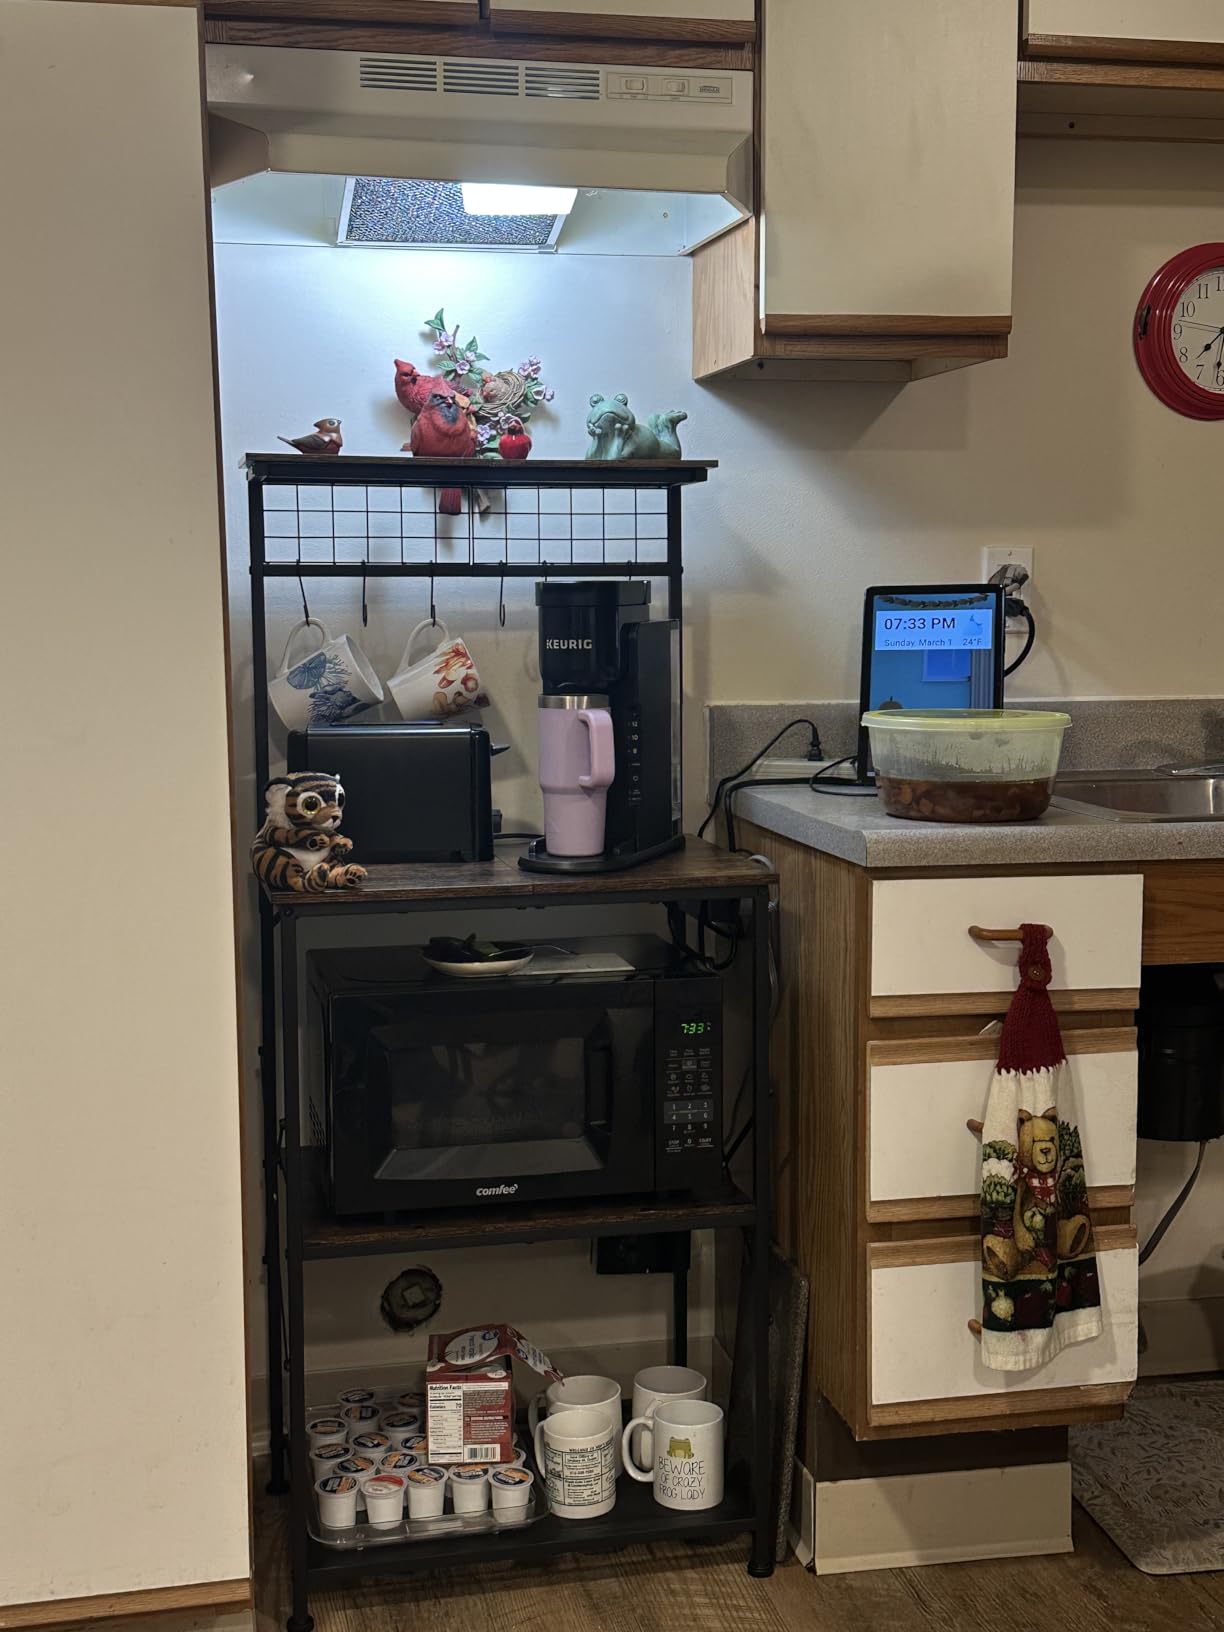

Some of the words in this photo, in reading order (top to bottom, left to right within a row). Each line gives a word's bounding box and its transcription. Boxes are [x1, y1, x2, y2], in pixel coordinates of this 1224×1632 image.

[1197, 283, 1209, 299] 11
[1216, 275, 1224, 292] 1
[1180, 301, 1196, 318] 10
[1173, 323, 1183, 341] 9
[1178, 346, 1189, 363] 8
[1195, 364, 1204, 380] 7
[884, 617, 926, 630] 07:33
[931, 617, 955, 629] PM
[546, 638, 593, 650] KEURIG
[918, 638, 946, 647] March
[680, 1022, 705, 1034] 7:33
[658, 1455, 706, 1476] BEWARE
[660, 1472, 670, 1484] OF
[672, 1475, 703, 1488] CRAZY
[659, 1483, 678, 1499] FROG
[680, 1488, 706, 1500] LADY
